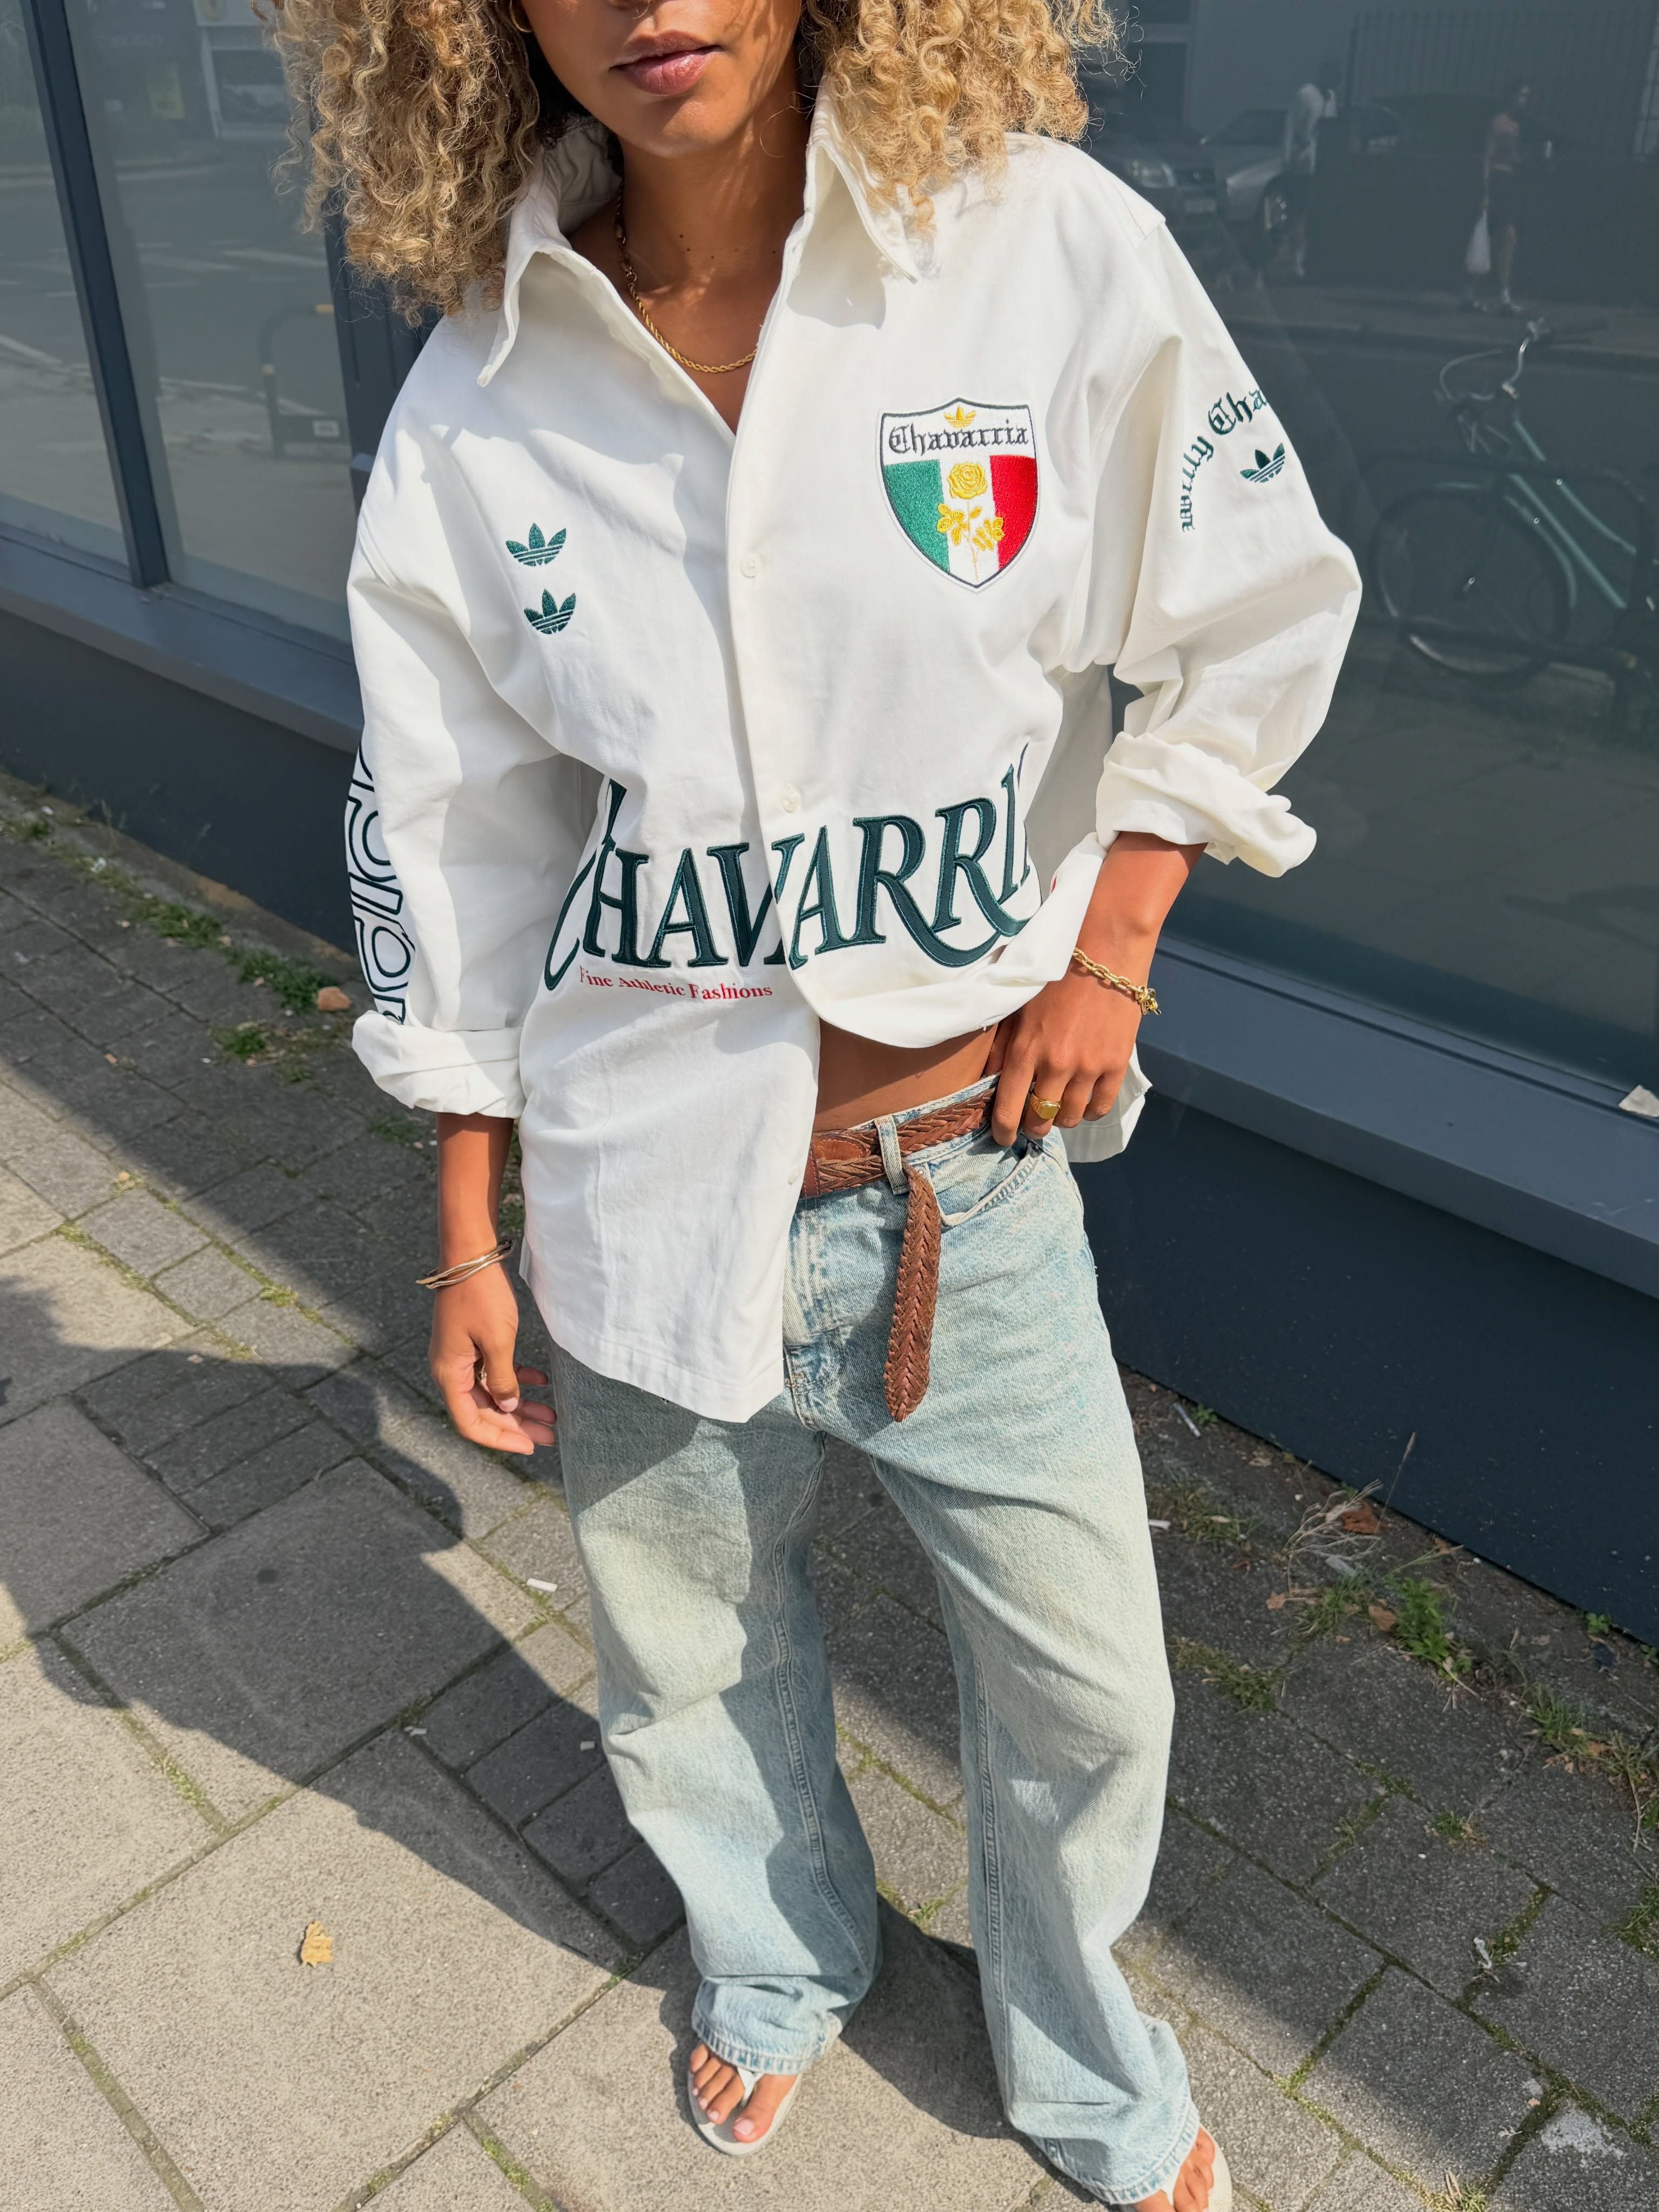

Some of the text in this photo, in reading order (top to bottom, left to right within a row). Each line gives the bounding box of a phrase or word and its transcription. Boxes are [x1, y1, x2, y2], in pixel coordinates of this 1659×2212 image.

[888, 419, 1029, 456] Chavarria
[1180, 436, 1214, 532] Willy
[544, 742, 1034, 991] CHAVARRI
[579, 966, 773, 1000] Fine Athletic Fashions
